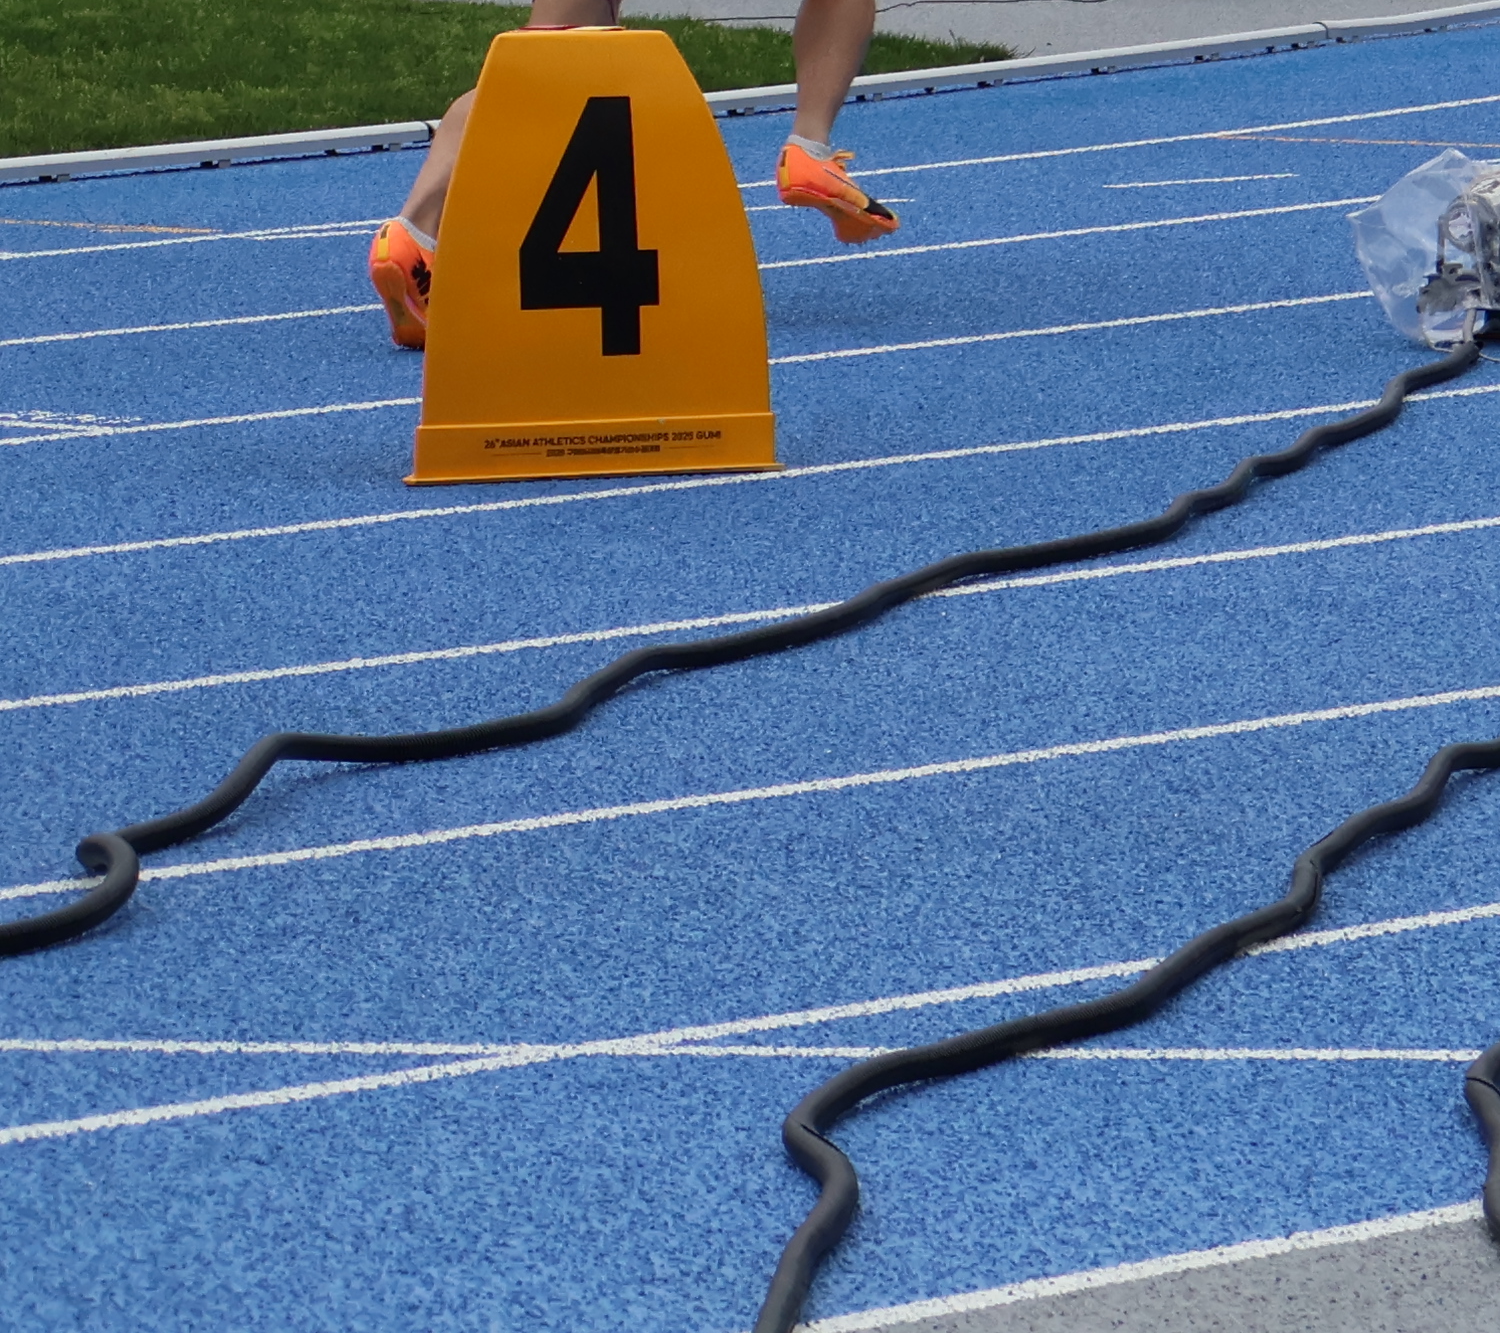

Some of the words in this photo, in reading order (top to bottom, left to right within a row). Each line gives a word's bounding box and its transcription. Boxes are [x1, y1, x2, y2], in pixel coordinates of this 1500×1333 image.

[519, 96, 660, 356] 4
[499, 438, 531, 449] ASIAN
[533, 435, 586, 448] ATHLETICS
[588, 432, 670, 445] CHAMPIONSHIPS
